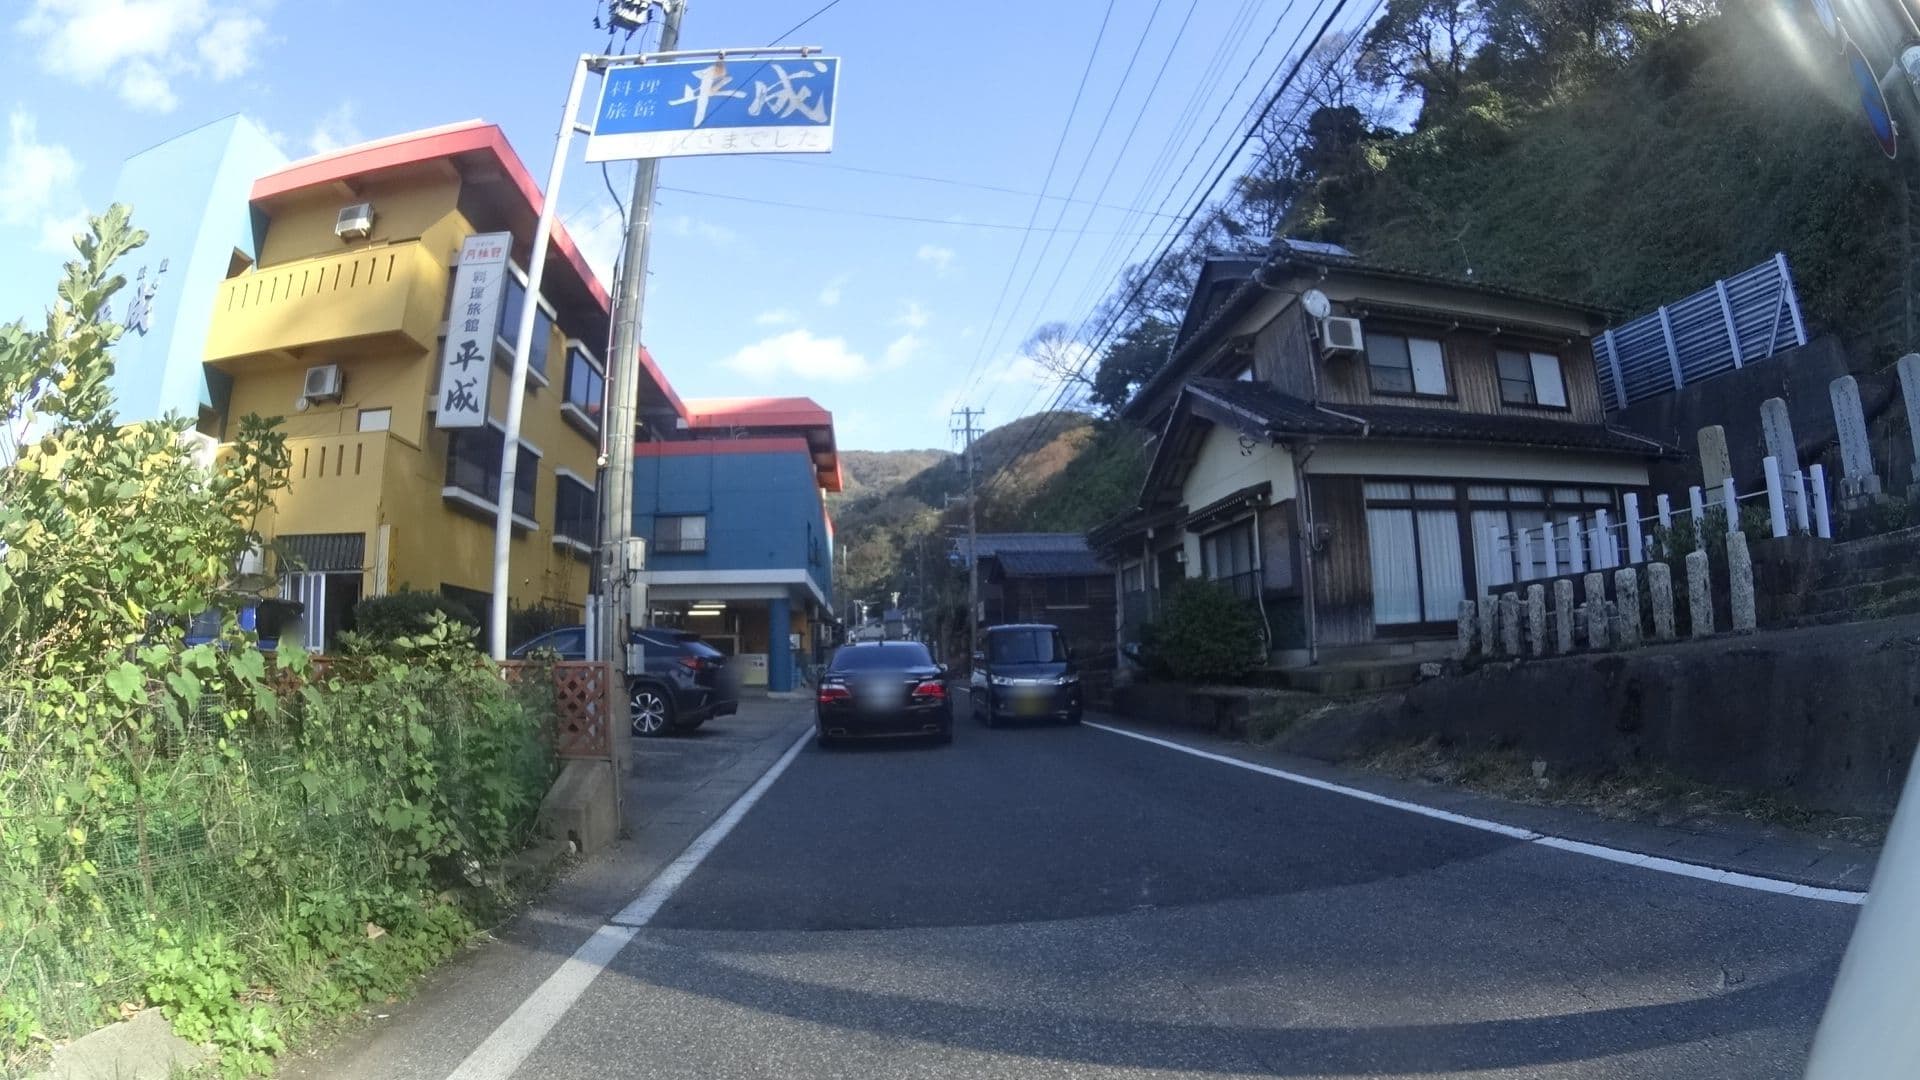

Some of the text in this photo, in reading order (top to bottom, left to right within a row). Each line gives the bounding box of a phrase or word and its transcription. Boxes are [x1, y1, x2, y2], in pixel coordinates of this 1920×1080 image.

[605, 99, 657, 120] 旅館
[668, 61, 829, 128] 平成
[445, 339, 486, 414] 平成
